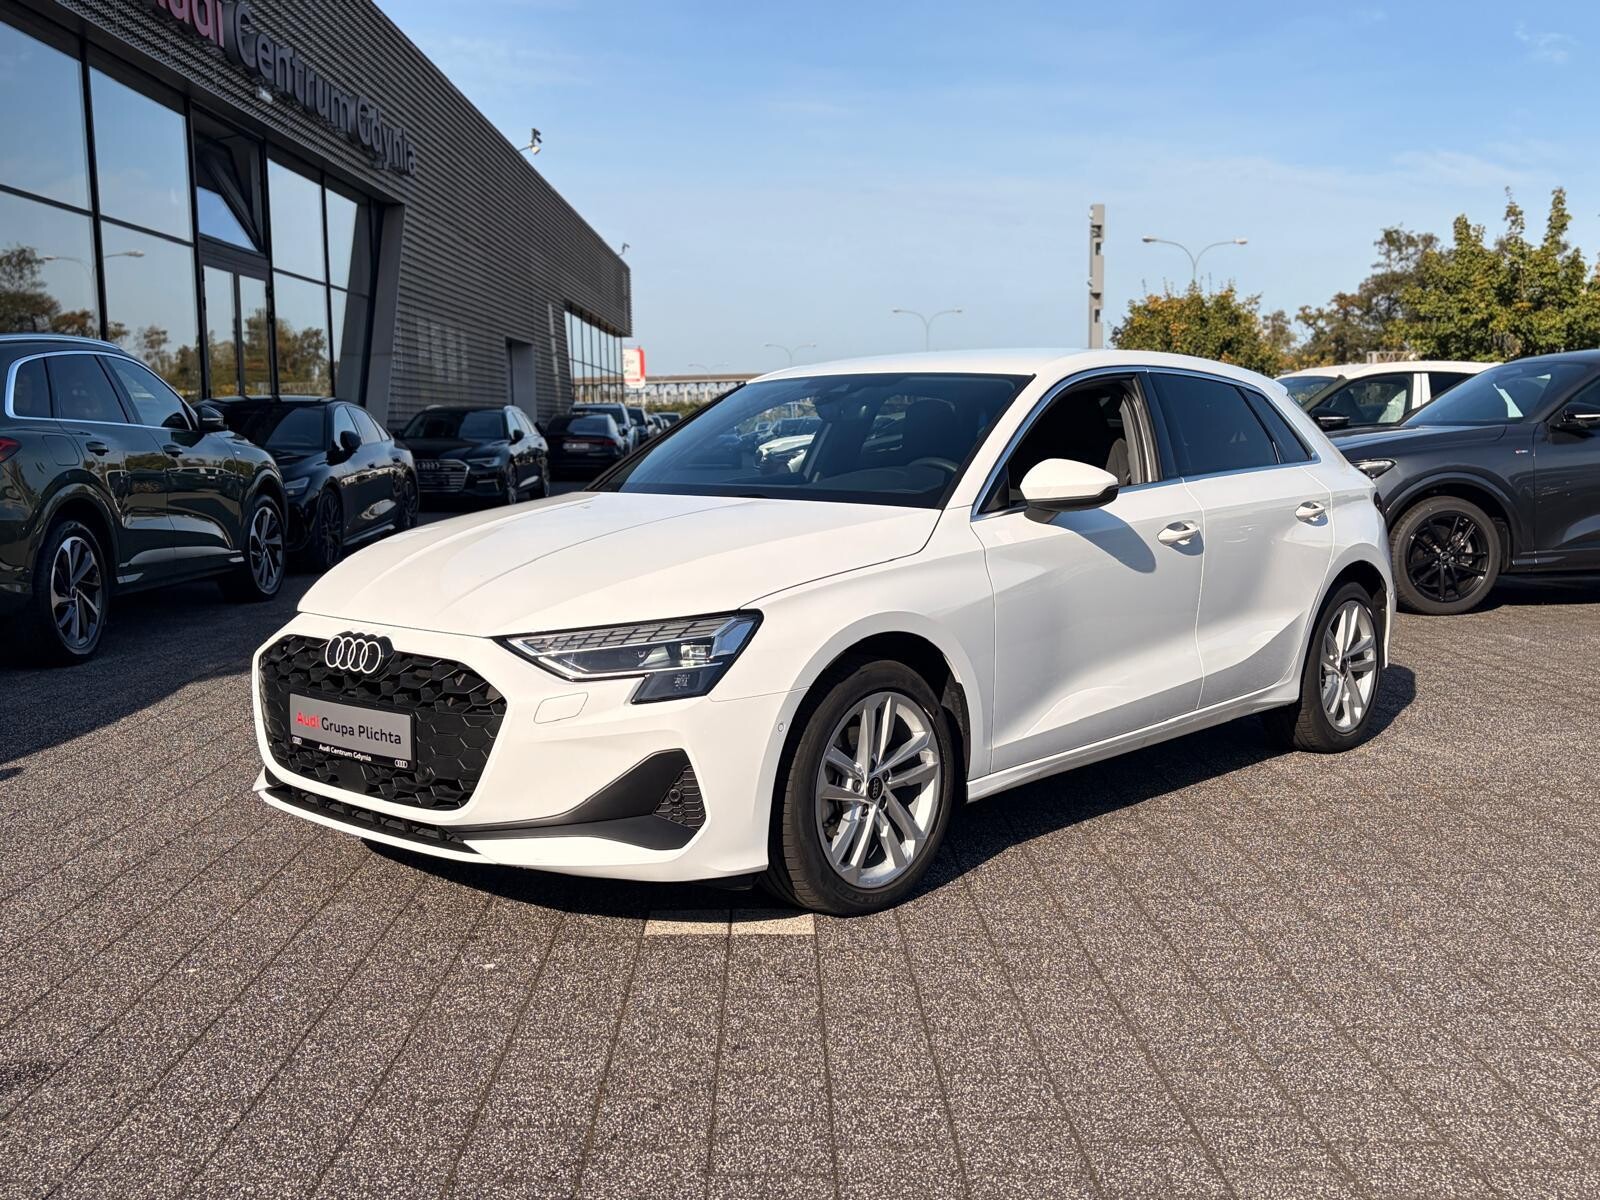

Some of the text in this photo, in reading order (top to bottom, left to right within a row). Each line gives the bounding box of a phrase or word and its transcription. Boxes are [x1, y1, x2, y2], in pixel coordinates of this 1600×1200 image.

[234, 1, 352, 134] Centrum
[357, 95, 417, 176] Gdynia
[296, 712, 402, 745] Audi Grupa Plichta
[319, 744, 372, 761] Audi Centrum Gdynia
